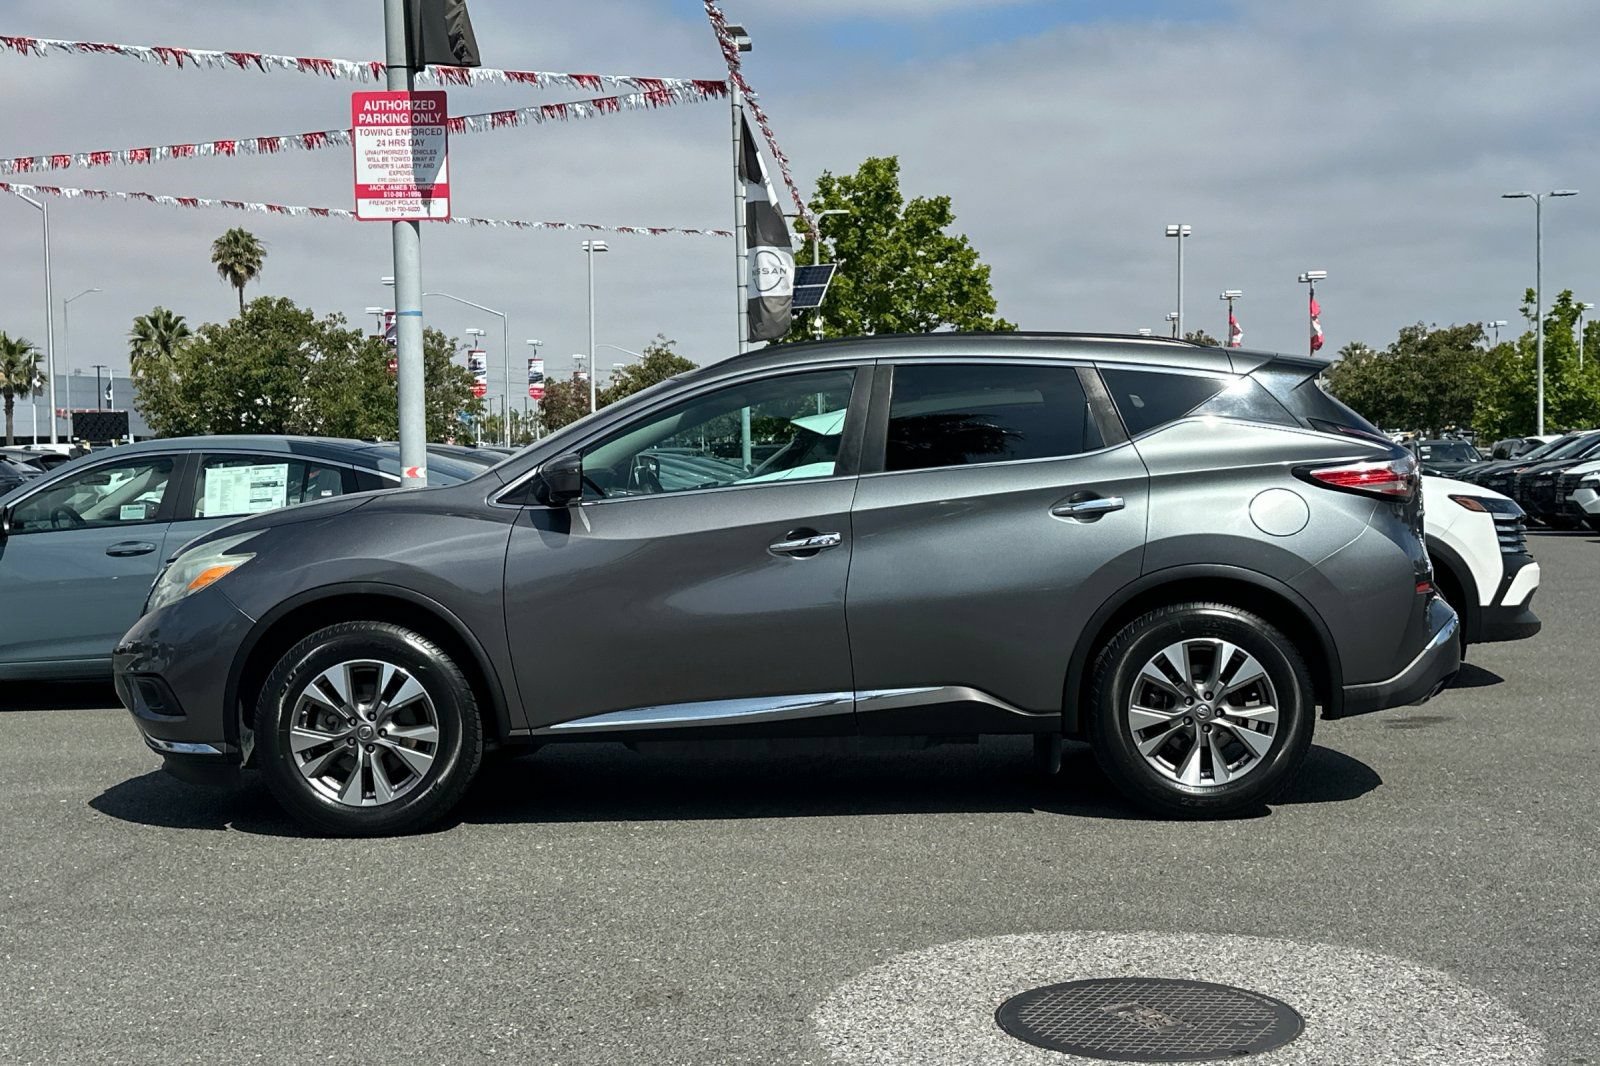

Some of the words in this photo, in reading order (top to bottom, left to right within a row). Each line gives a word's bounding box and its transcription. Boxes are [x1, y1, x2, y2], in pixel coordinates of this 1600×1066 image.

[363, 100, 436, 111] AUTHORIZED
[358, 113, 409, 124] PARKING
[412, 112, 442, 123] ONLY
[359, 128, 393, 137] TOWING
[395, 128, 443, 136] ENFORCED
[376, 139, 386, 147] 24
[388, 139, 406, 147] HRS
[408, 139, 426, 147] DAY
